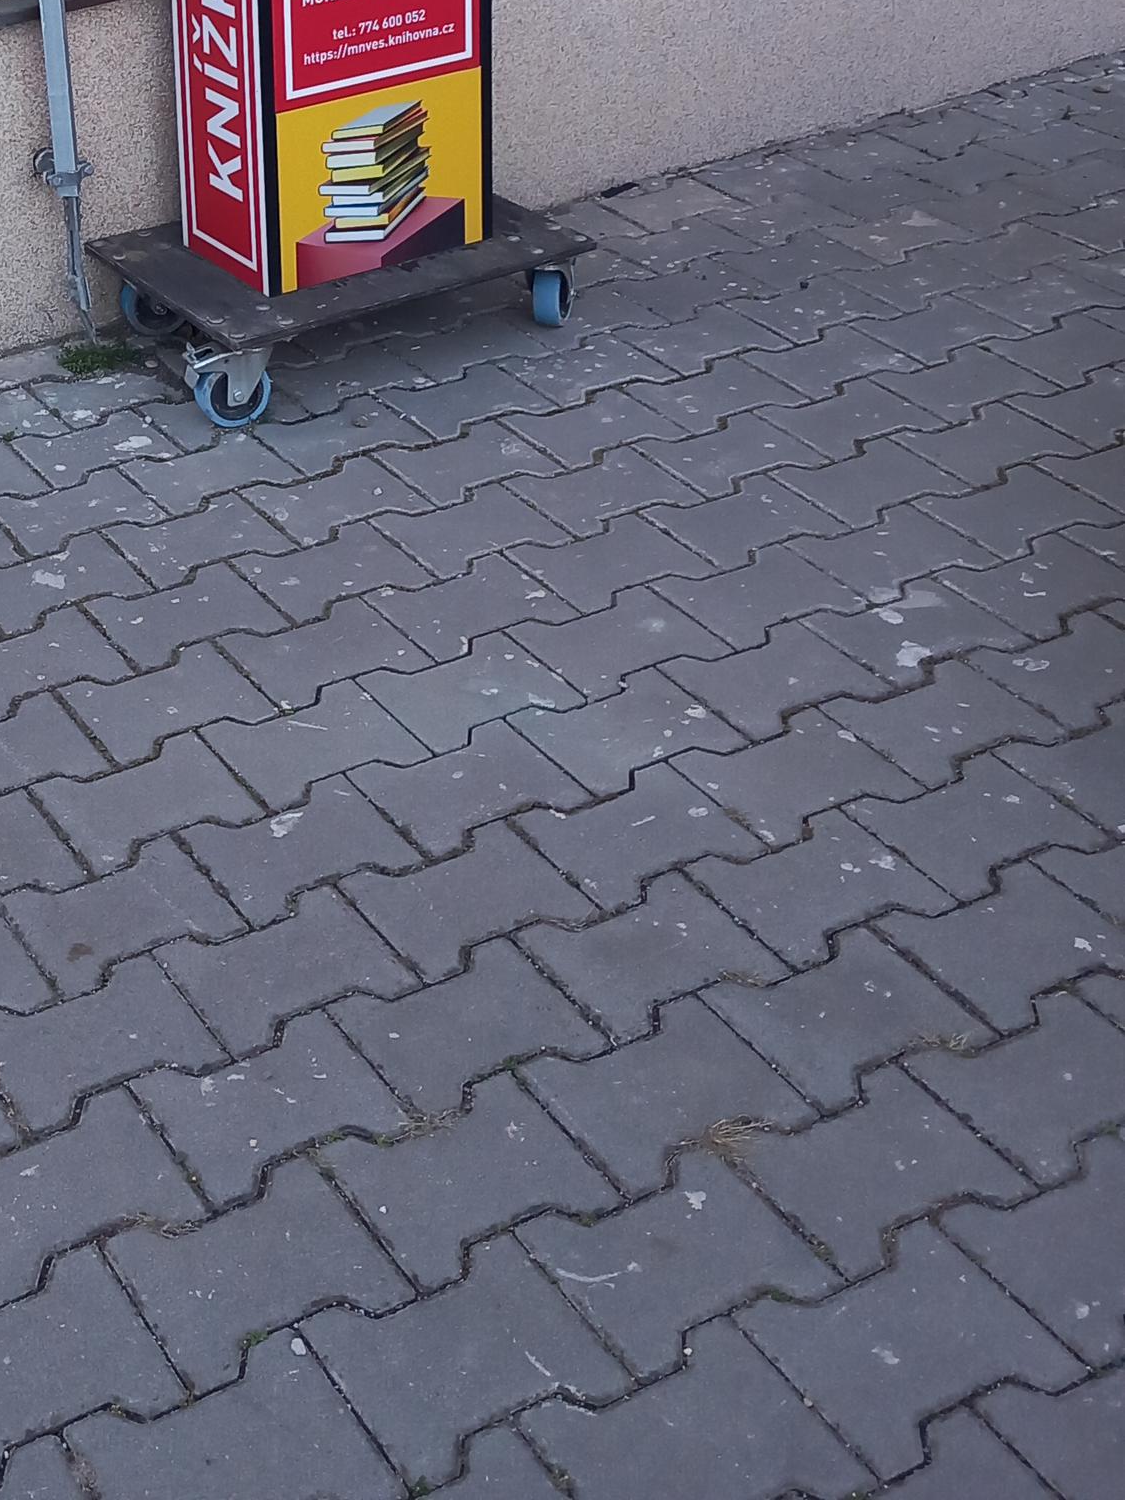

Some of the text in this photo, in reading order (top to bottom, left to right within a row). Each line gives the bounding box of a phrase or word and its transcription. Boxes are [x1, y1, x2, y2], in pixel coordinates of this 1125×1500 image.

[332, 9, 427, 40] tel.: 774 600 052
[303, 23, 455, 65] https://mnves.knihovna.cz
